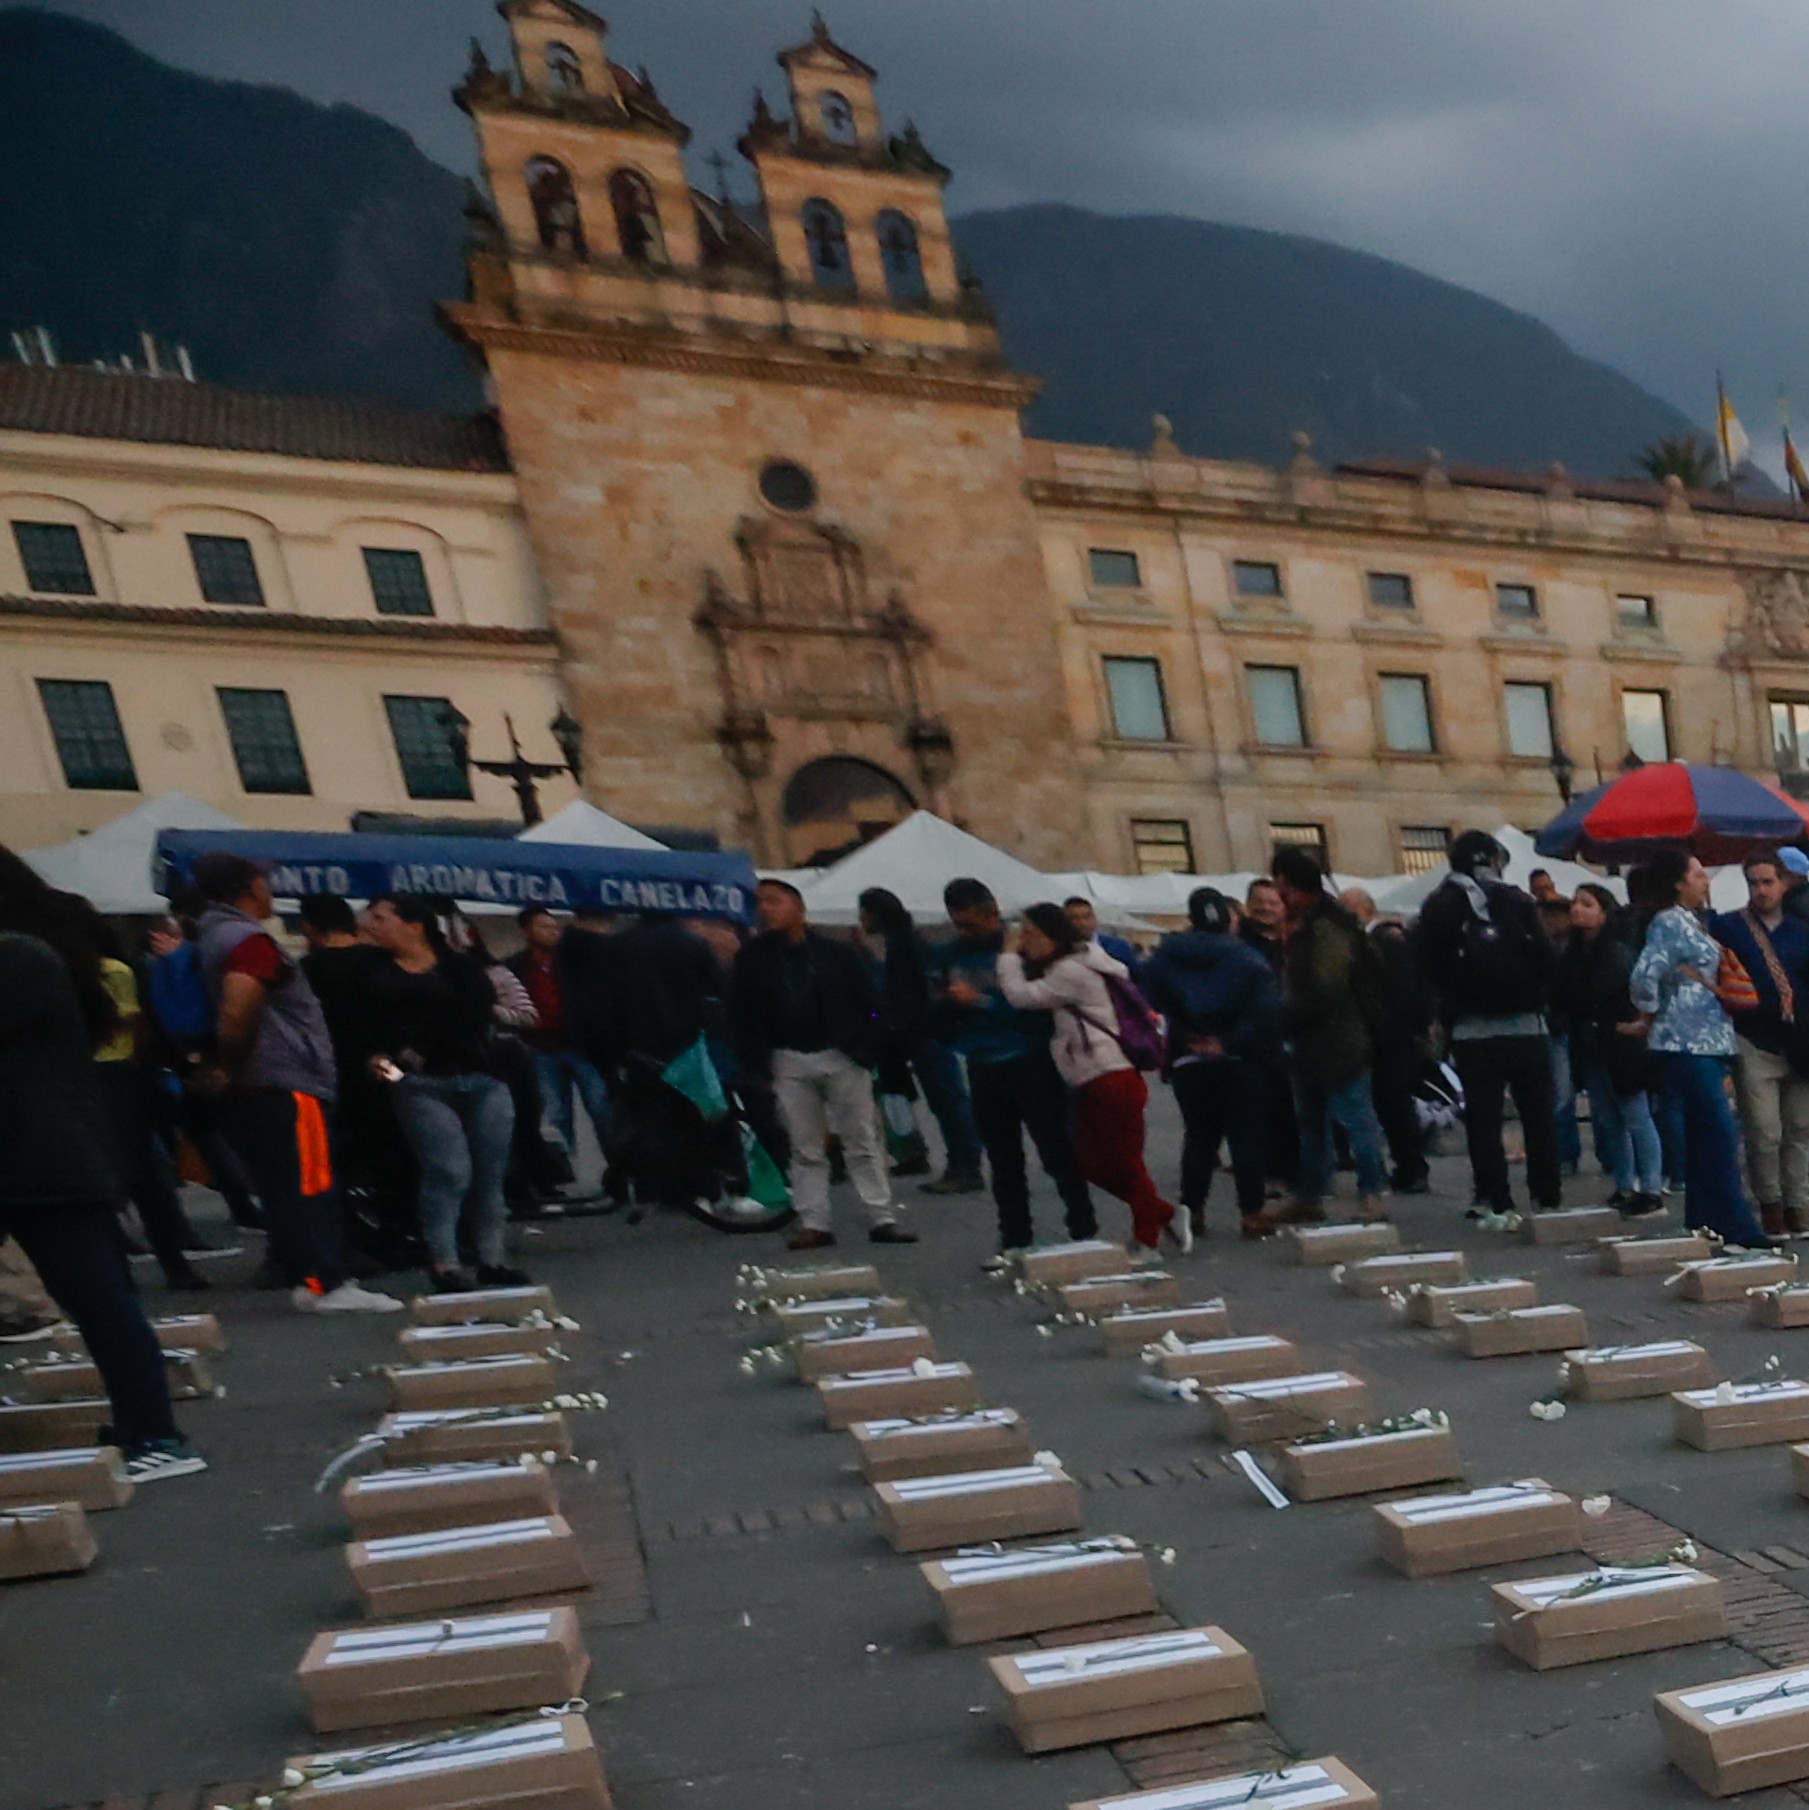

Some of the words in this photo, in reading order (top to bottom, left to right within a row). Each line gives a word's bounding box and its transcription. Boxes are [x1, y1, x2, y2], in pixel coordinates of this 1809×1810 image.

[267, 863, 350, 894] NTO
[391, 863, 569, 904] AROMATICA
[599, 877, 745, 913] CANELAZO
